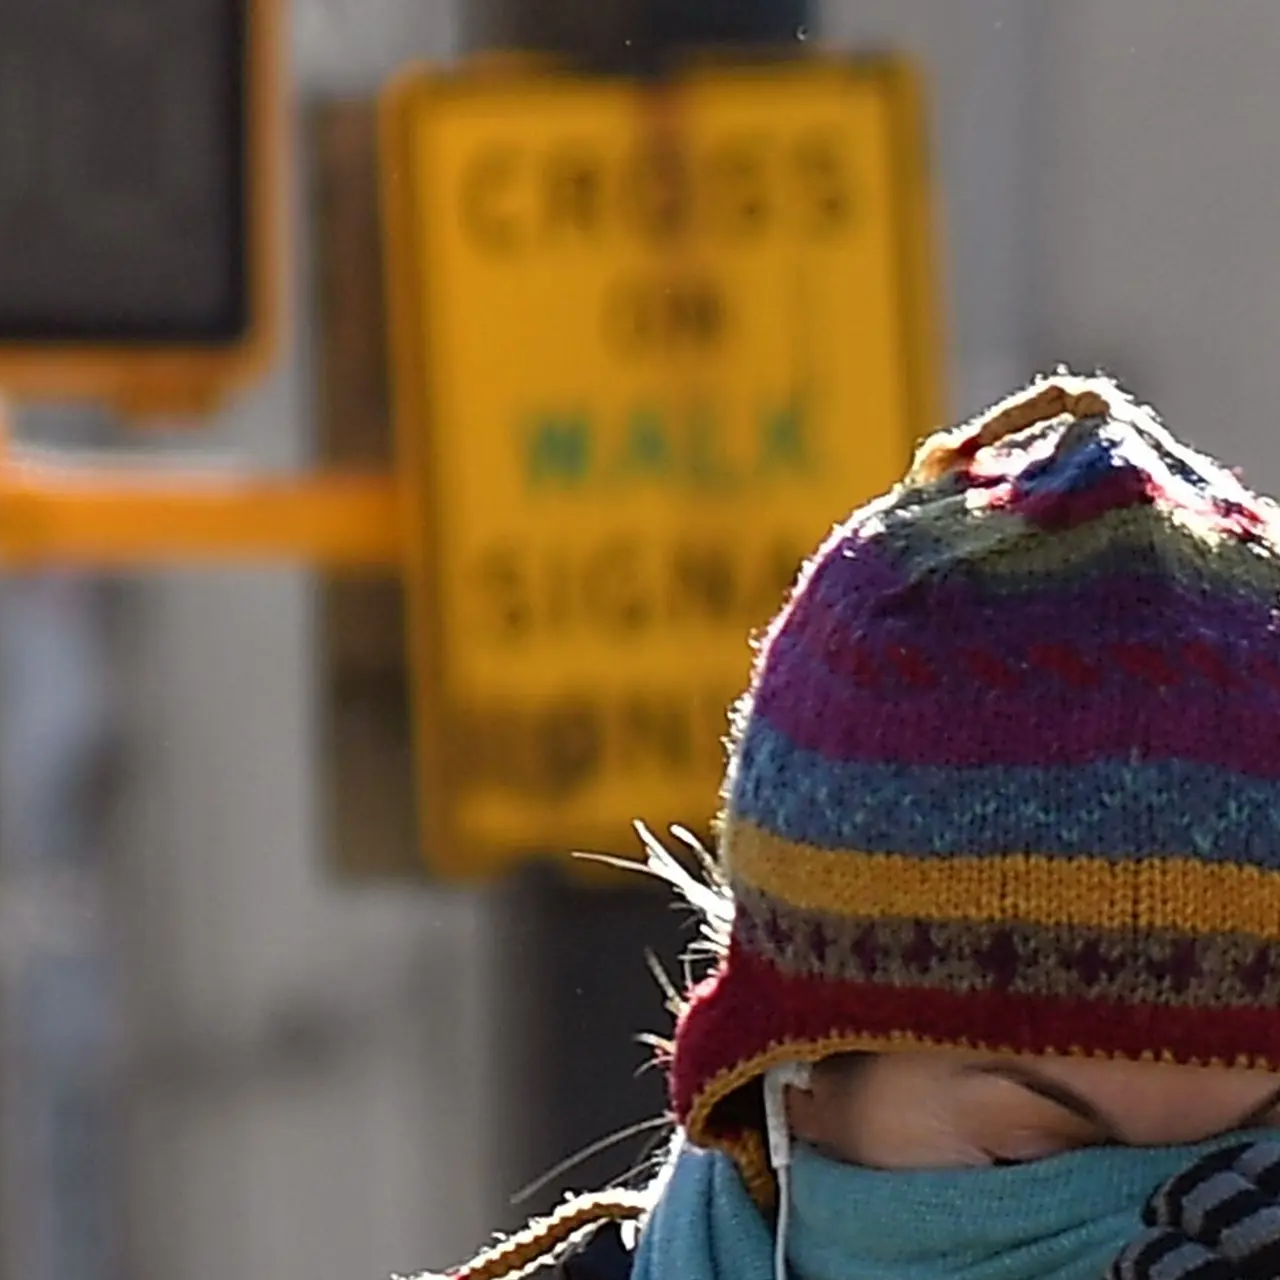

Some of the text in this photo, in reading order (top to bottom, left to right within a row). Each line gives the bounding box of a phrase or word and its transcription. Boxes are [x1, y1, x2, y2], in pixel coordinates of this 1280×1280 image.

[457, 132, 854, 256] CROSS
[600, 280, 726, 362] ON
[525, 403, 818, 491] WALK
[476, 540, 810, 634] SIGN
